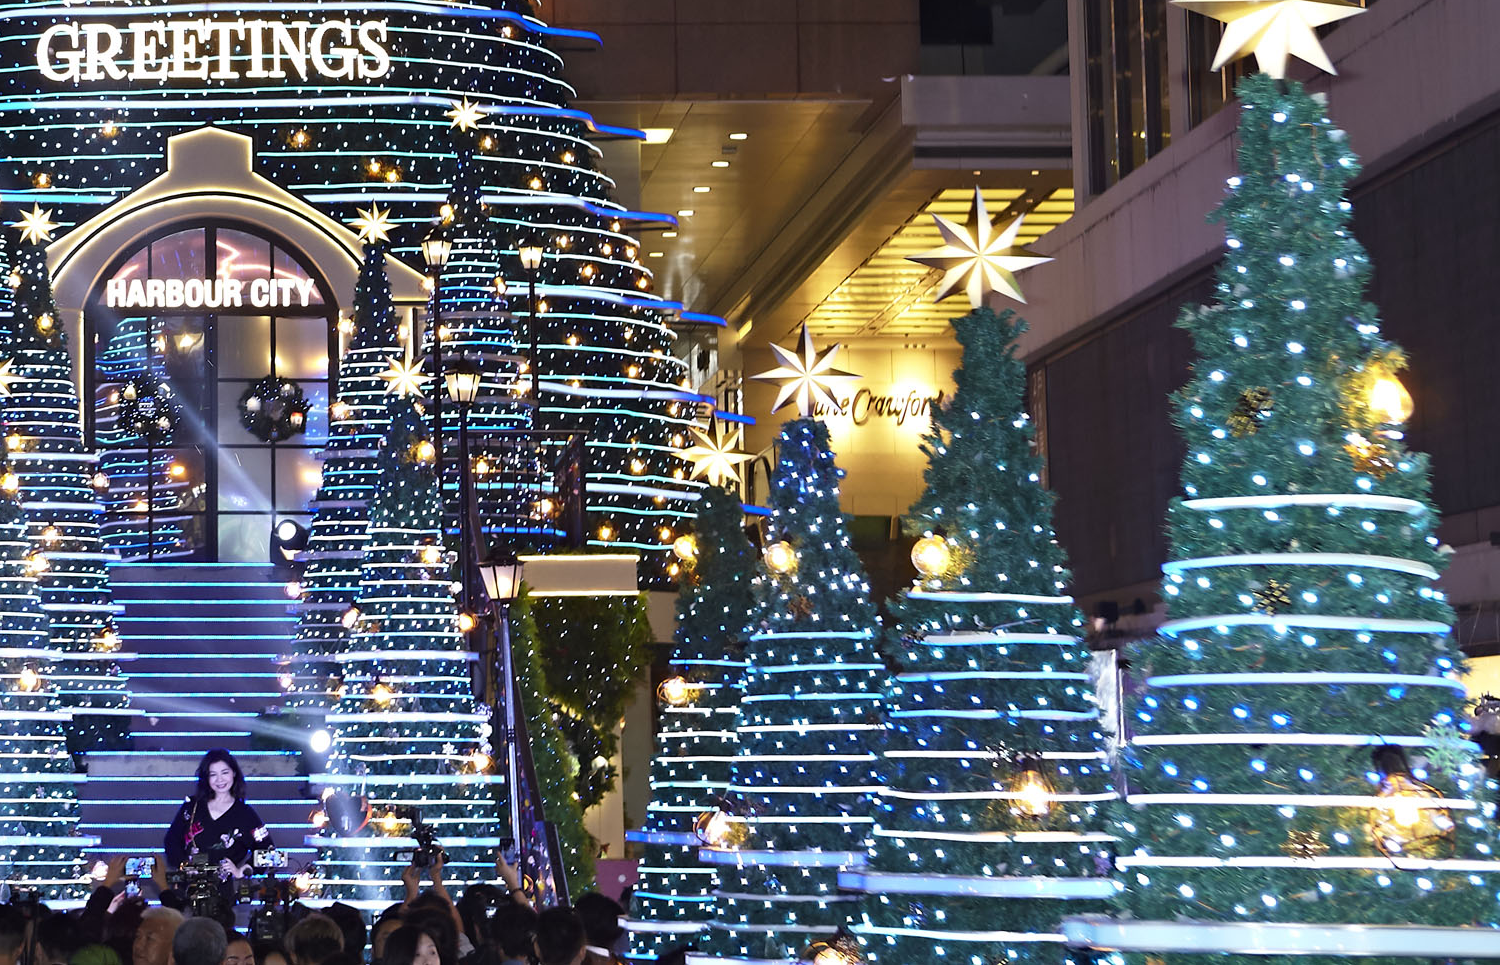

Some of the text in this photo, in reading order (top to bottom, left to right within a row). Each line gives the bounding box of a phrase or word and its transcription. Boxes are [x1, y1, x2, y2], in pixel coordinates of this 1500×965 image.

[36, 19, 390, 82] GREETINGS
[107, 278, 315, 307] HARBOUR CITY
